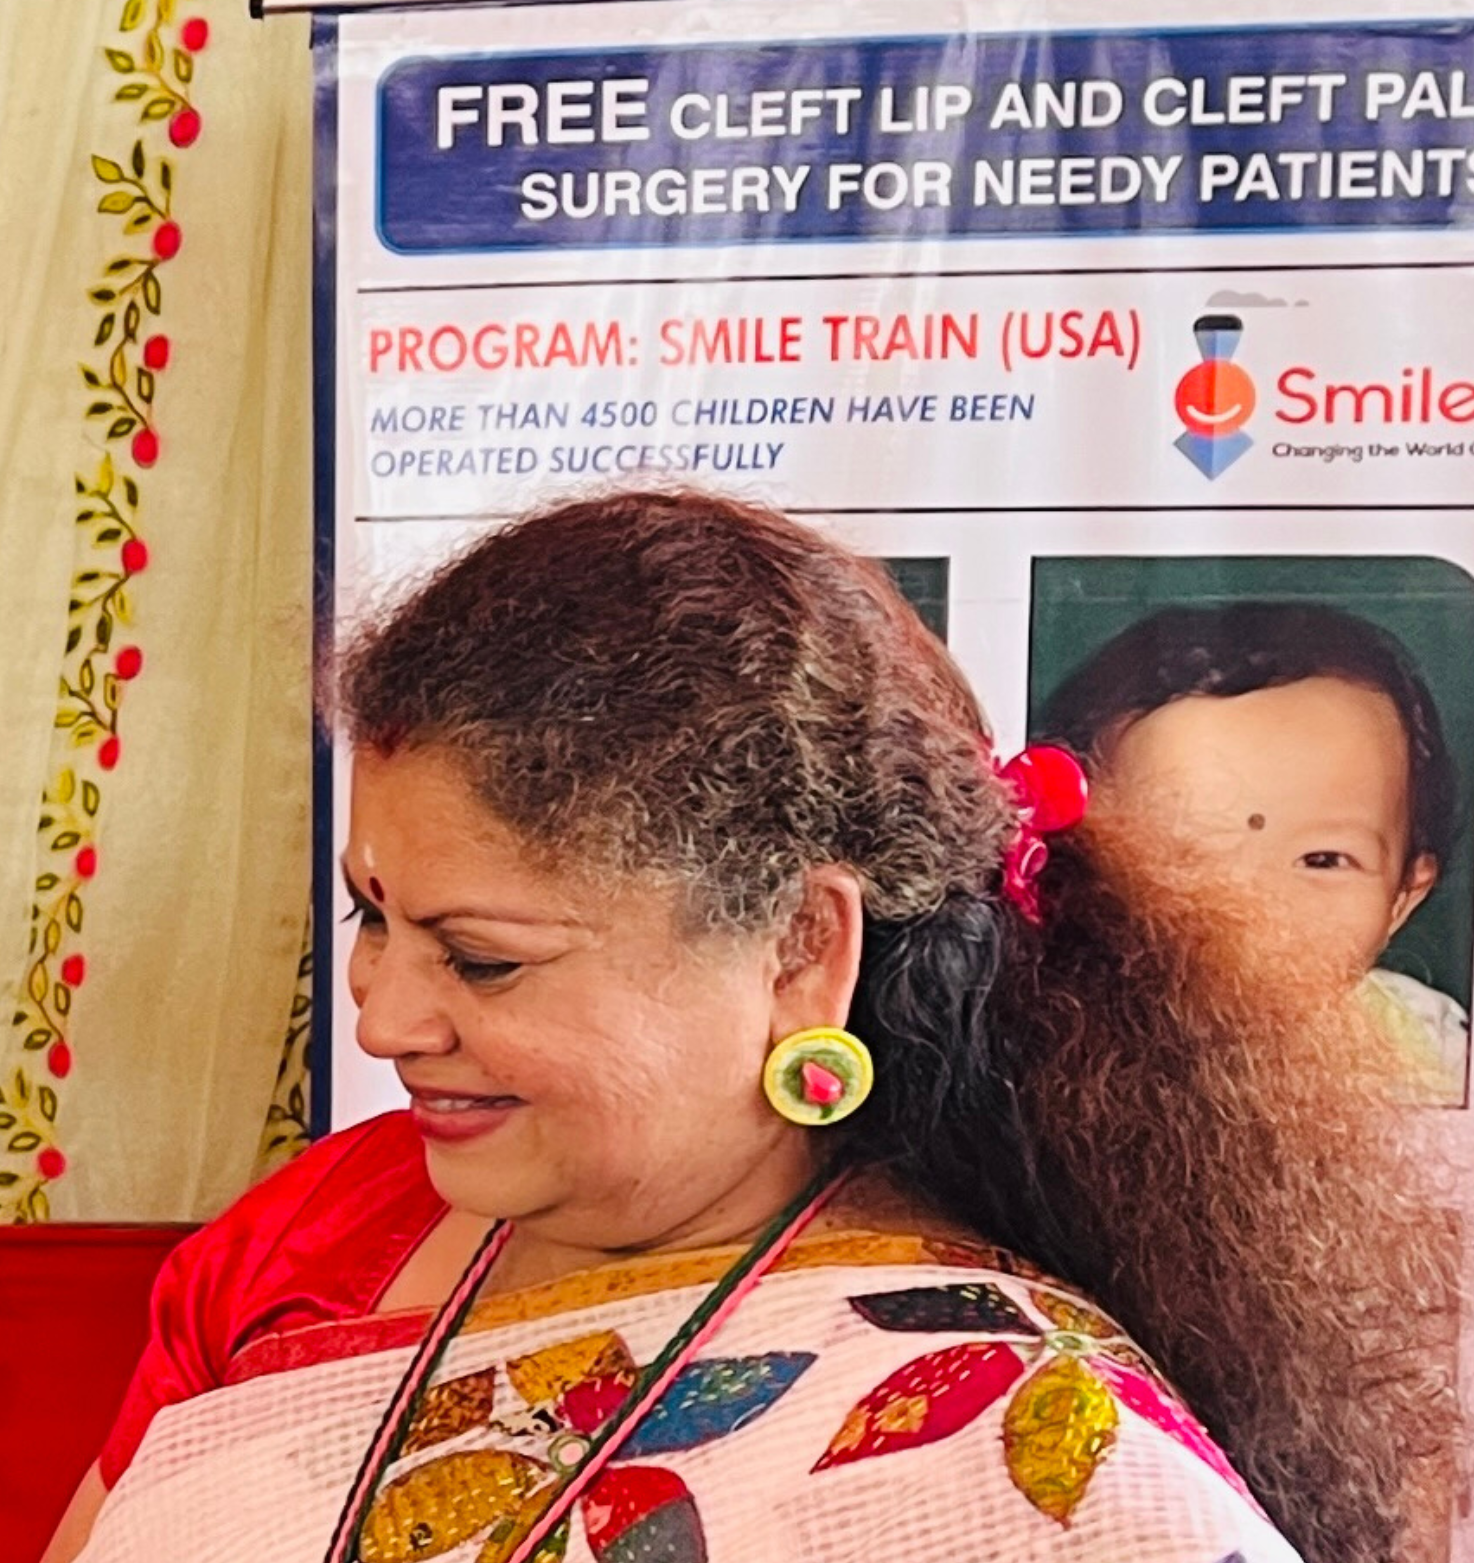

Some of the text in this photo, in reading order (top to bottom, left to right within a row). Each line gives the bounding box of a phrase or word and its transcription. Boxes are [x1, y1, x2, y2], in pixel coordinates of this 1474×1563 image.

[436, 77, 651, 149] FREE
[668, 87, 862, 140] CLEFT
[879, 86, 972, 133] LIP
[989, 79, 1123, 129] AND
[1143, 73, 1347, 127] CLEFT
[519, 147, 1474, 220] SURGERY FOR NEEDY PATIENT
[369, 309, 1142, 373] PROGRAM: SMILE TRAIN (USA)
[370, 393, 1036, 433] MORE THAN 4500 CHILDREN HAVE BEEN
[1274, 366, 1474, 424] Smile
[370, 442, 786, 478] OPERATED SUCCESSFULLY
[1271, 441, 1364, 463] Changing
[1368, 442, 1400, 457] the
[1405, 441, 1465, 457] World
